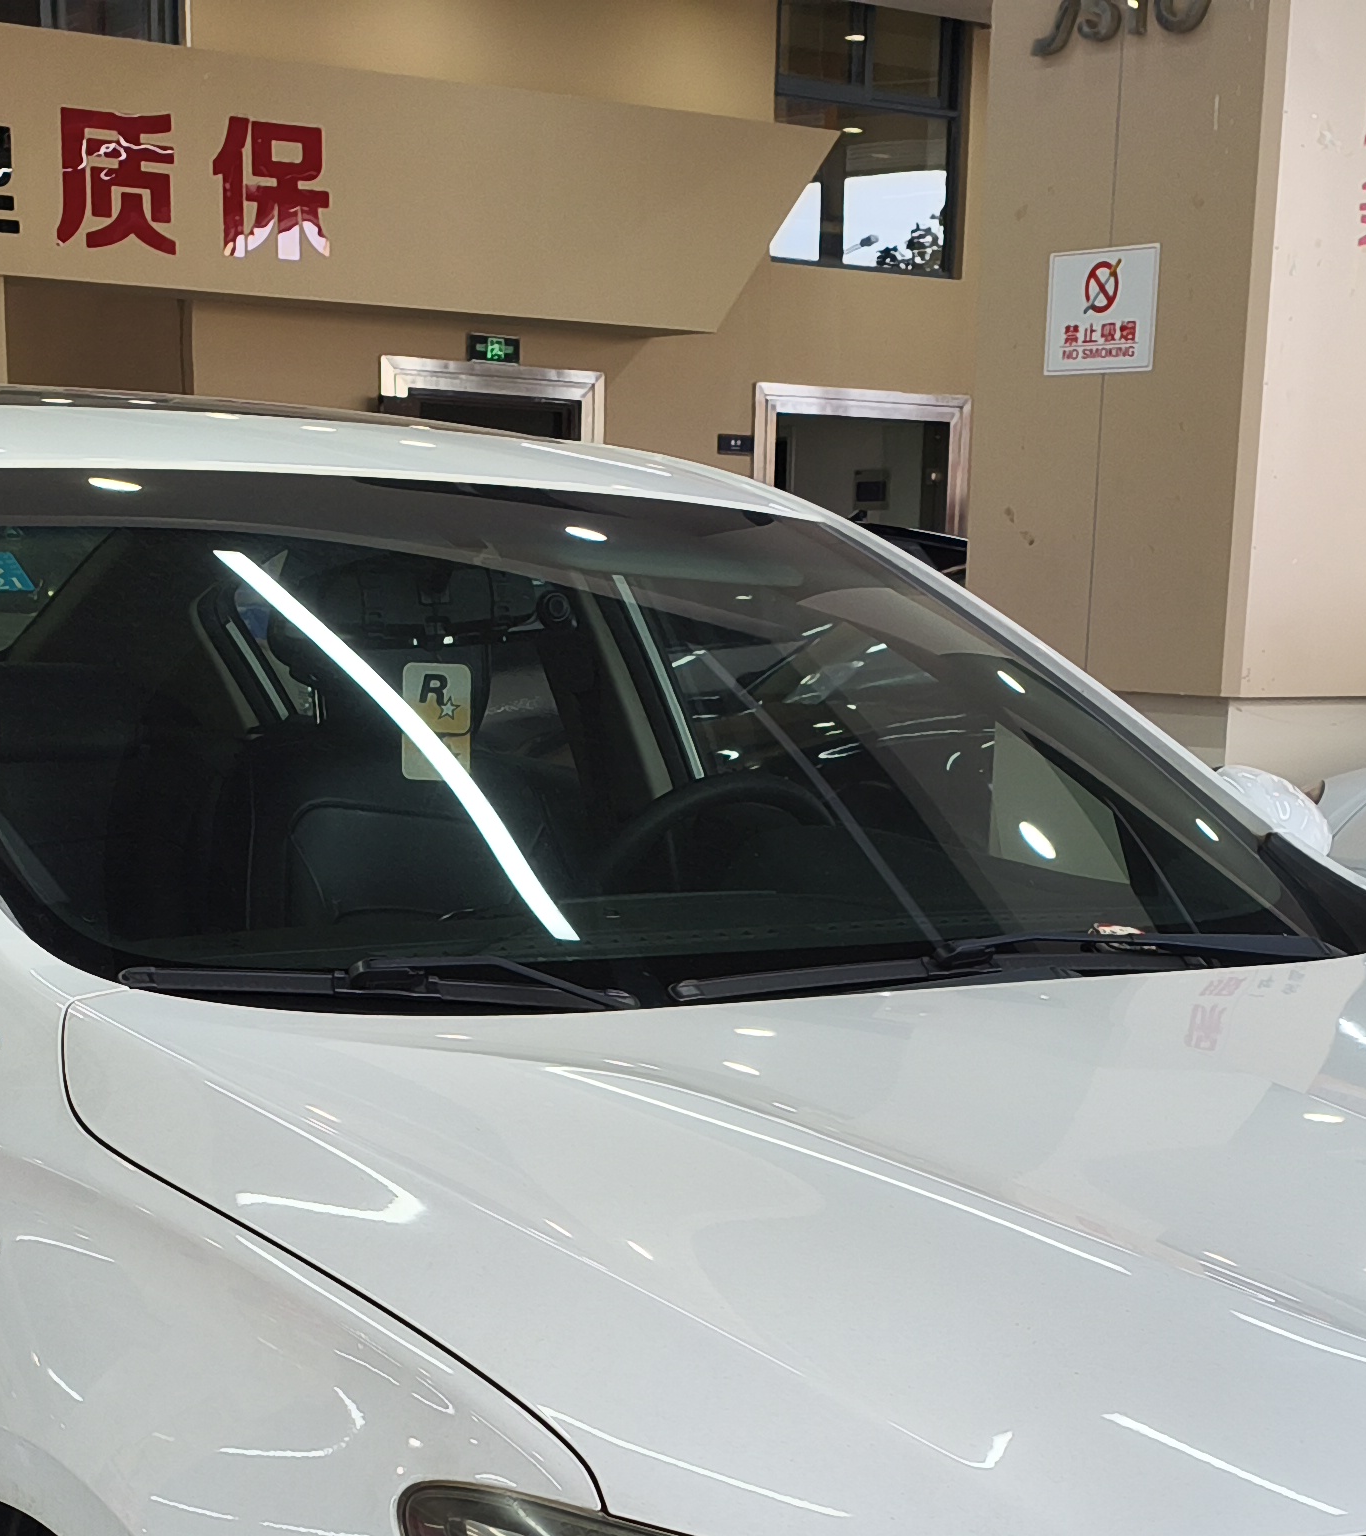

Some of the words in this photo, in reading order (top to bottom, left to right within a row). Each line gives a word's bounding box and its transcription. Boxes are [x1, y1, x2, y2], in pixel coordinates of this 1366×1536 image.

[1064, 320, 1137, 346] 禁止吸烟
[1062, 348, 1079, 360] NO
[1081, 346, 1135, 360] SMOKING
